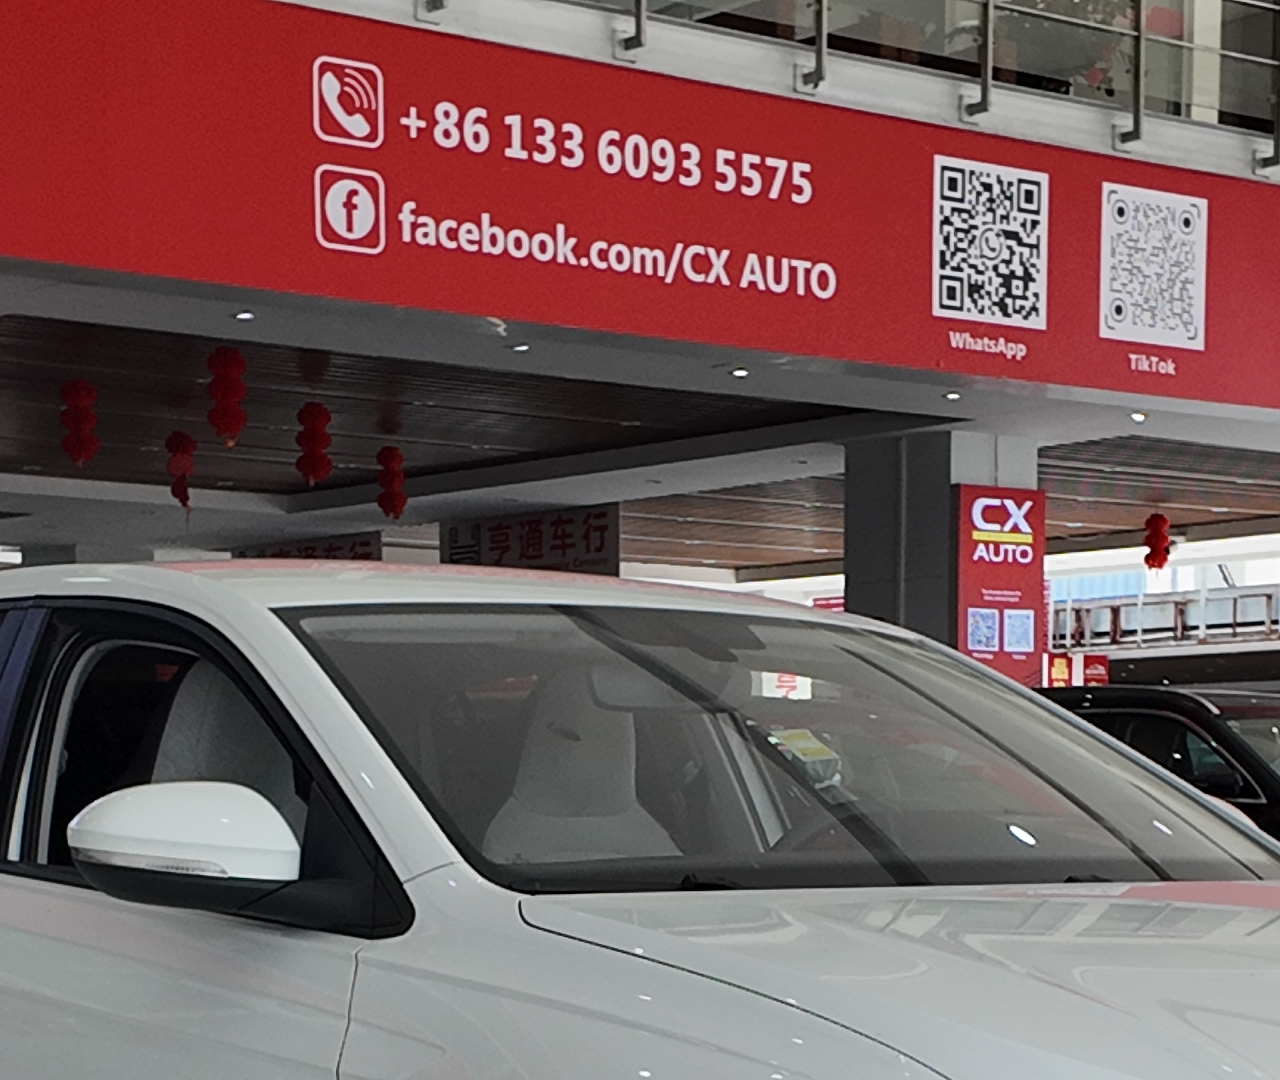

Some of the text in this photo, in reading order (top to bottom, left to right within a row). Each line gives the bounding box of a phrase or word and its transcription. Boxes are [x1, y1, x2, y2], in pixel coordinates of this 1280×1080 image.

[399, 100, 814, 205] +86 133 6093 5575
[397, 201, 837, 301] facebook.com/CX AUTO
[948, 330, 1028, 362] WhatsApp
[1128, 352, 1177, 377] TikTok
[971, 498, 1033, 533] CX
[487, 511, 609, 564] 亨通车行
[972, 543, 1033, 564] AUTO
